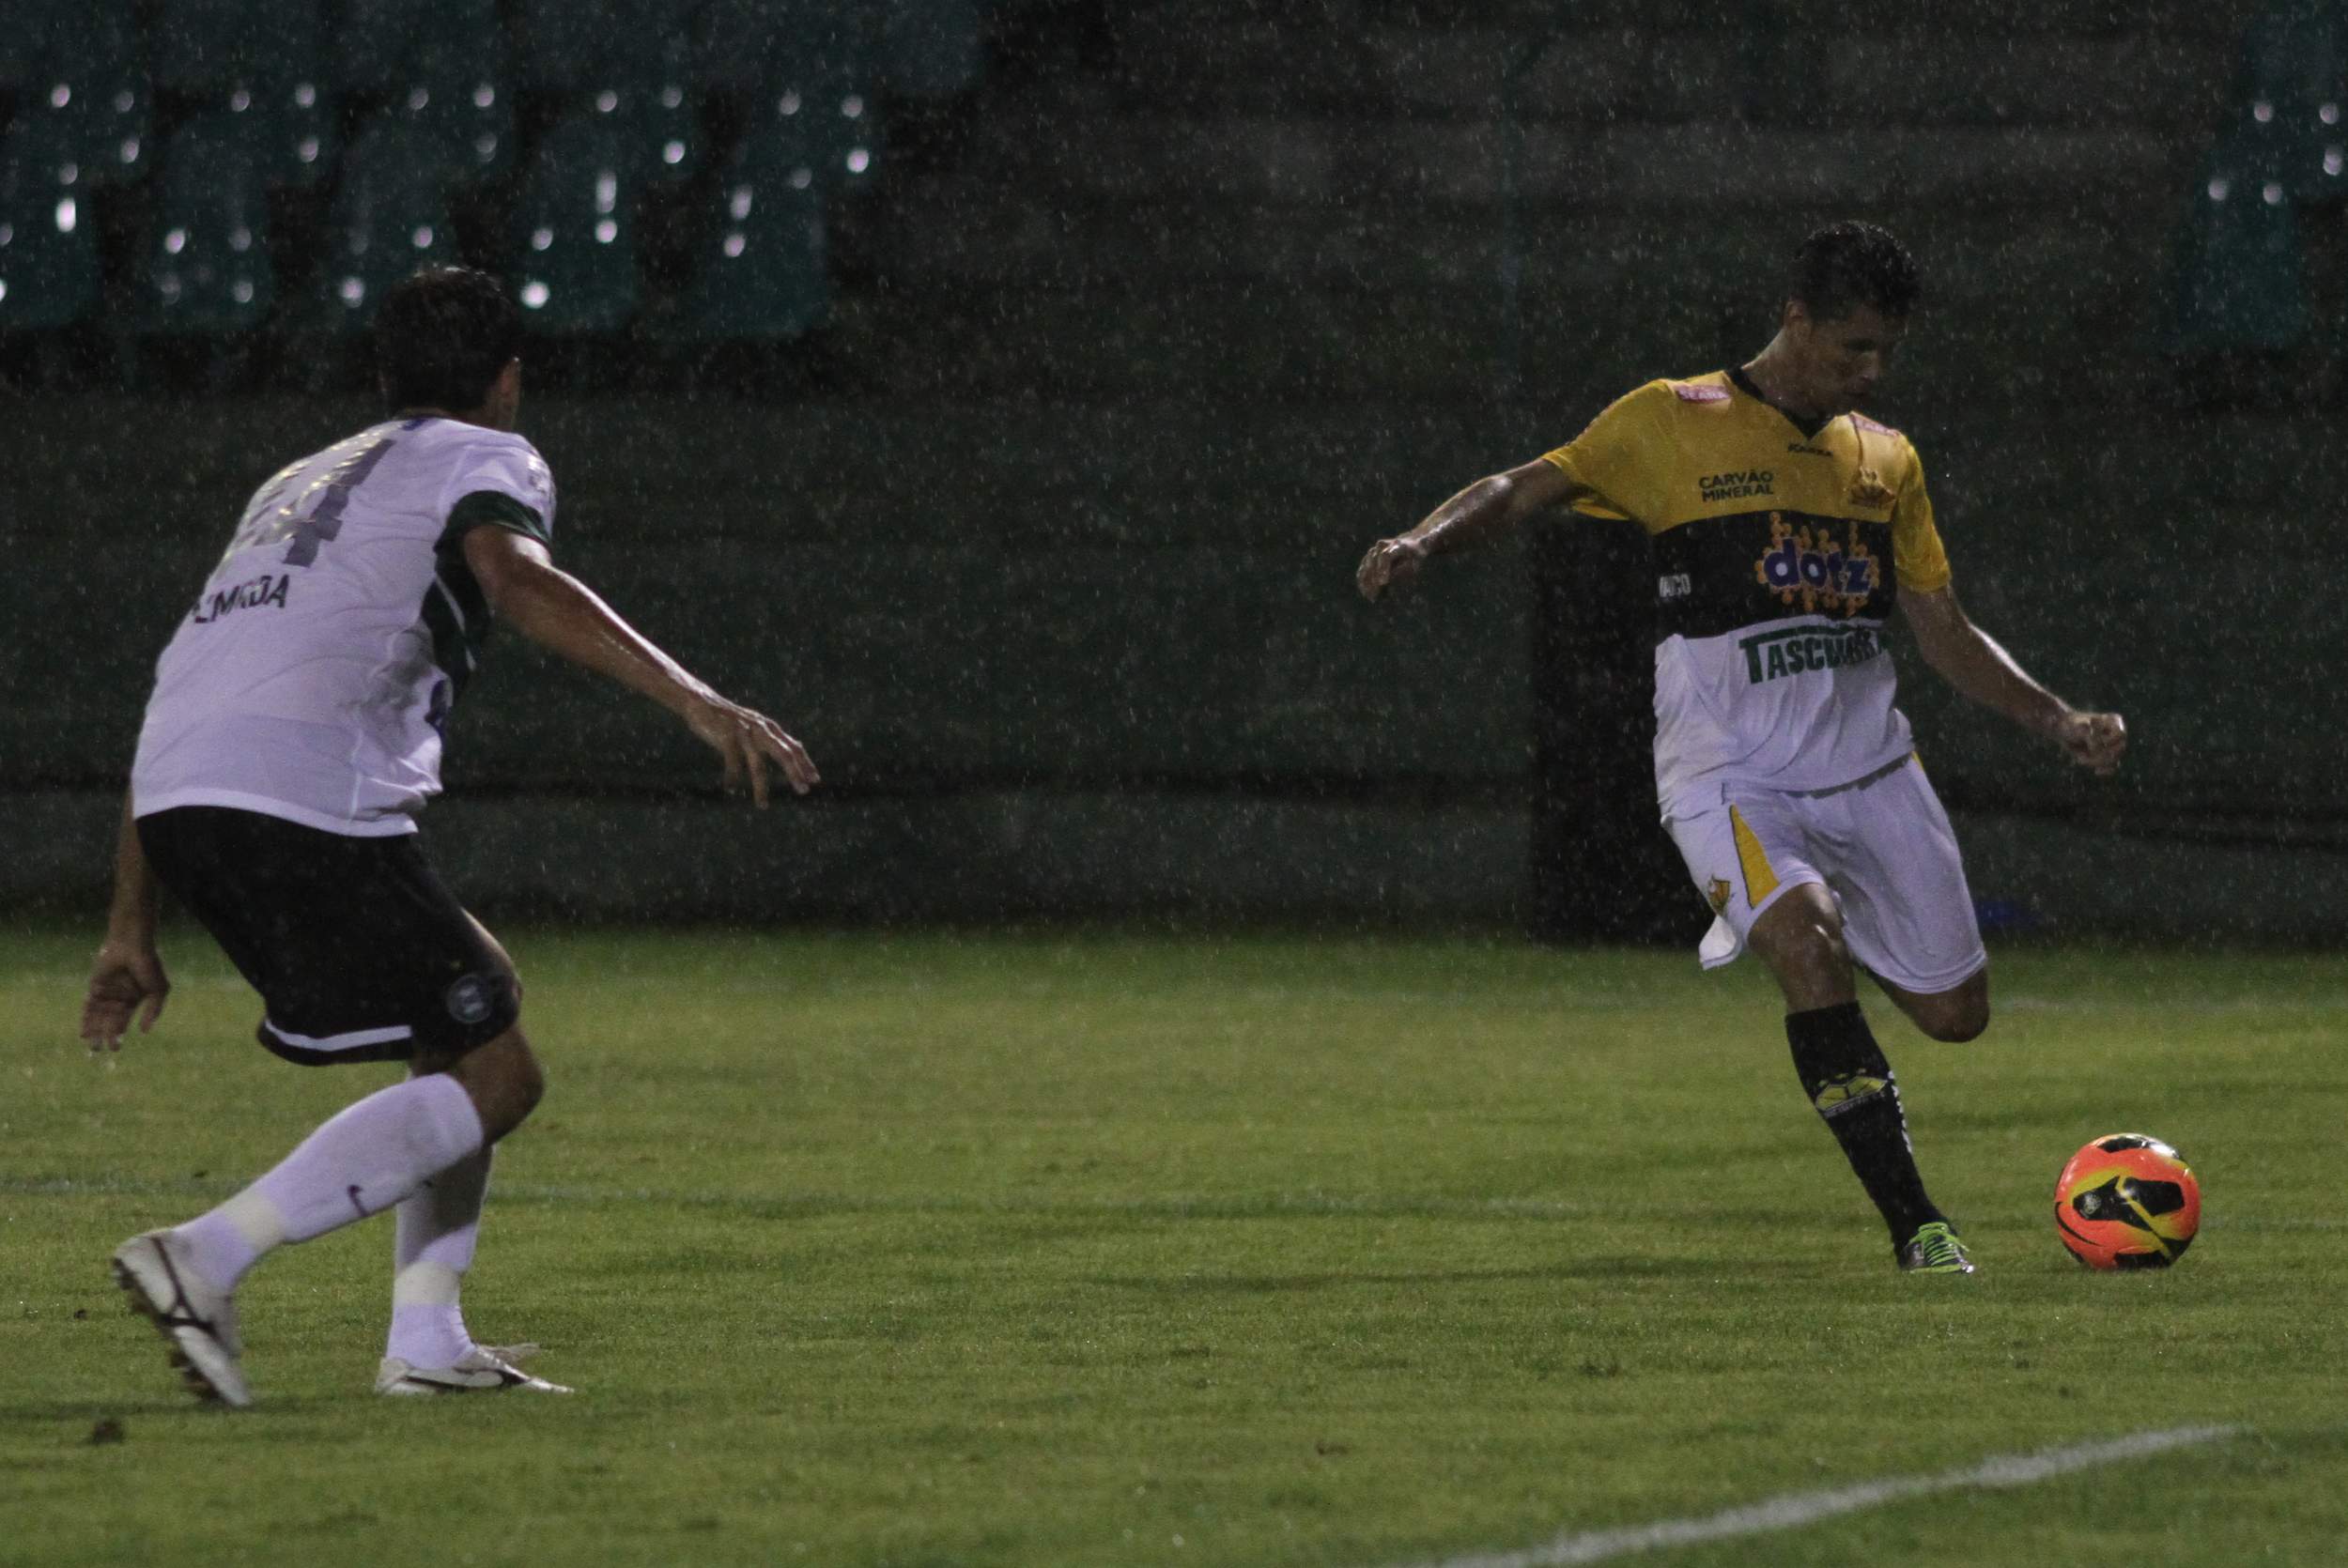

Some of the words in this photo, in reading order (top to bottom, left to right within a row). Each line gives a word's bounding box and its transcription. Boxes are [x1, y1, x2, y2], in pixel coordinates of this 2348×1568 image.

[1698, 470, 1773, 489] CARVÃO
[1701, 483, 1774, 502] MINERAL
[1764, 537, 1869, 593] dotz
